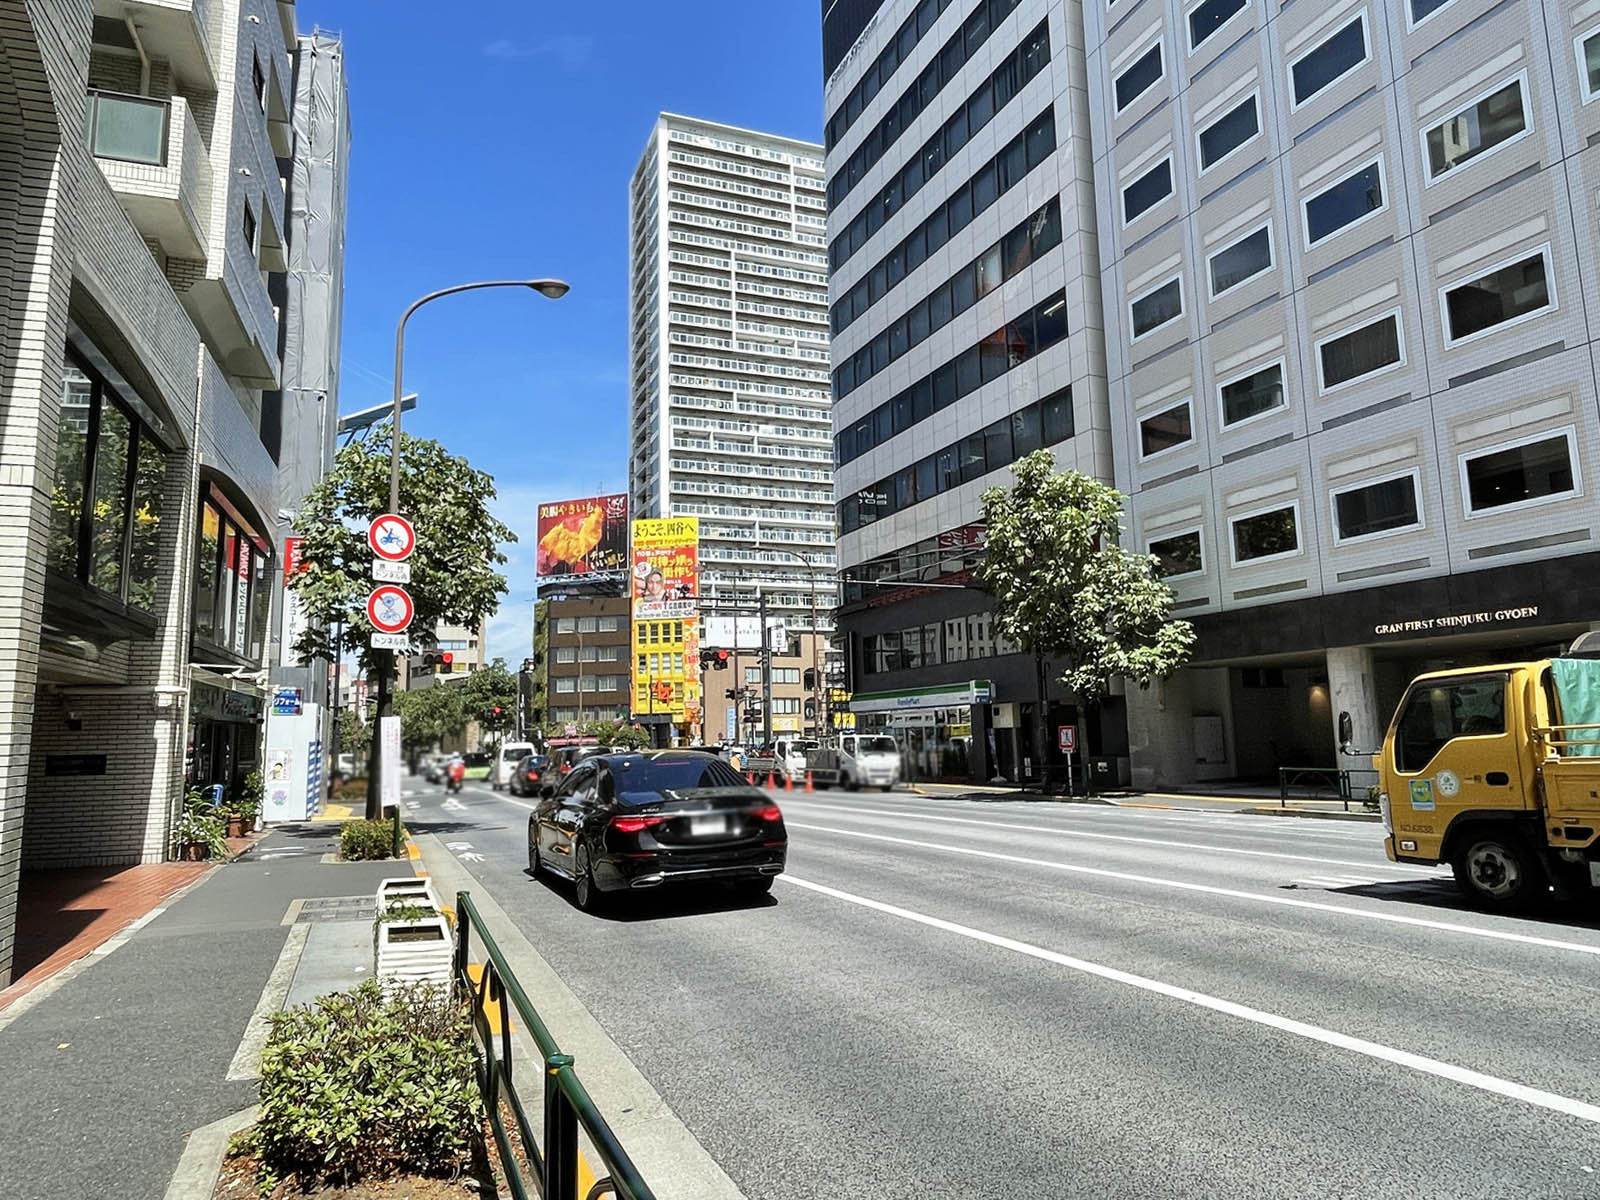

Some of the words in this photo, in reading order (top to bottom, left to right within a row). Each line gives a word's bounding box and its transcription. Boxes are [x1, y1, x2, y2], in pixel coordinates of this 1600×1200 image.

[1375, 623, 1404, 635] GRAN
[1405, 619, 1435, 631] FIRST
[1436, 612, 1493, 628] SHINJUKU
[1495, 606, 1539, 621] GYOEN
